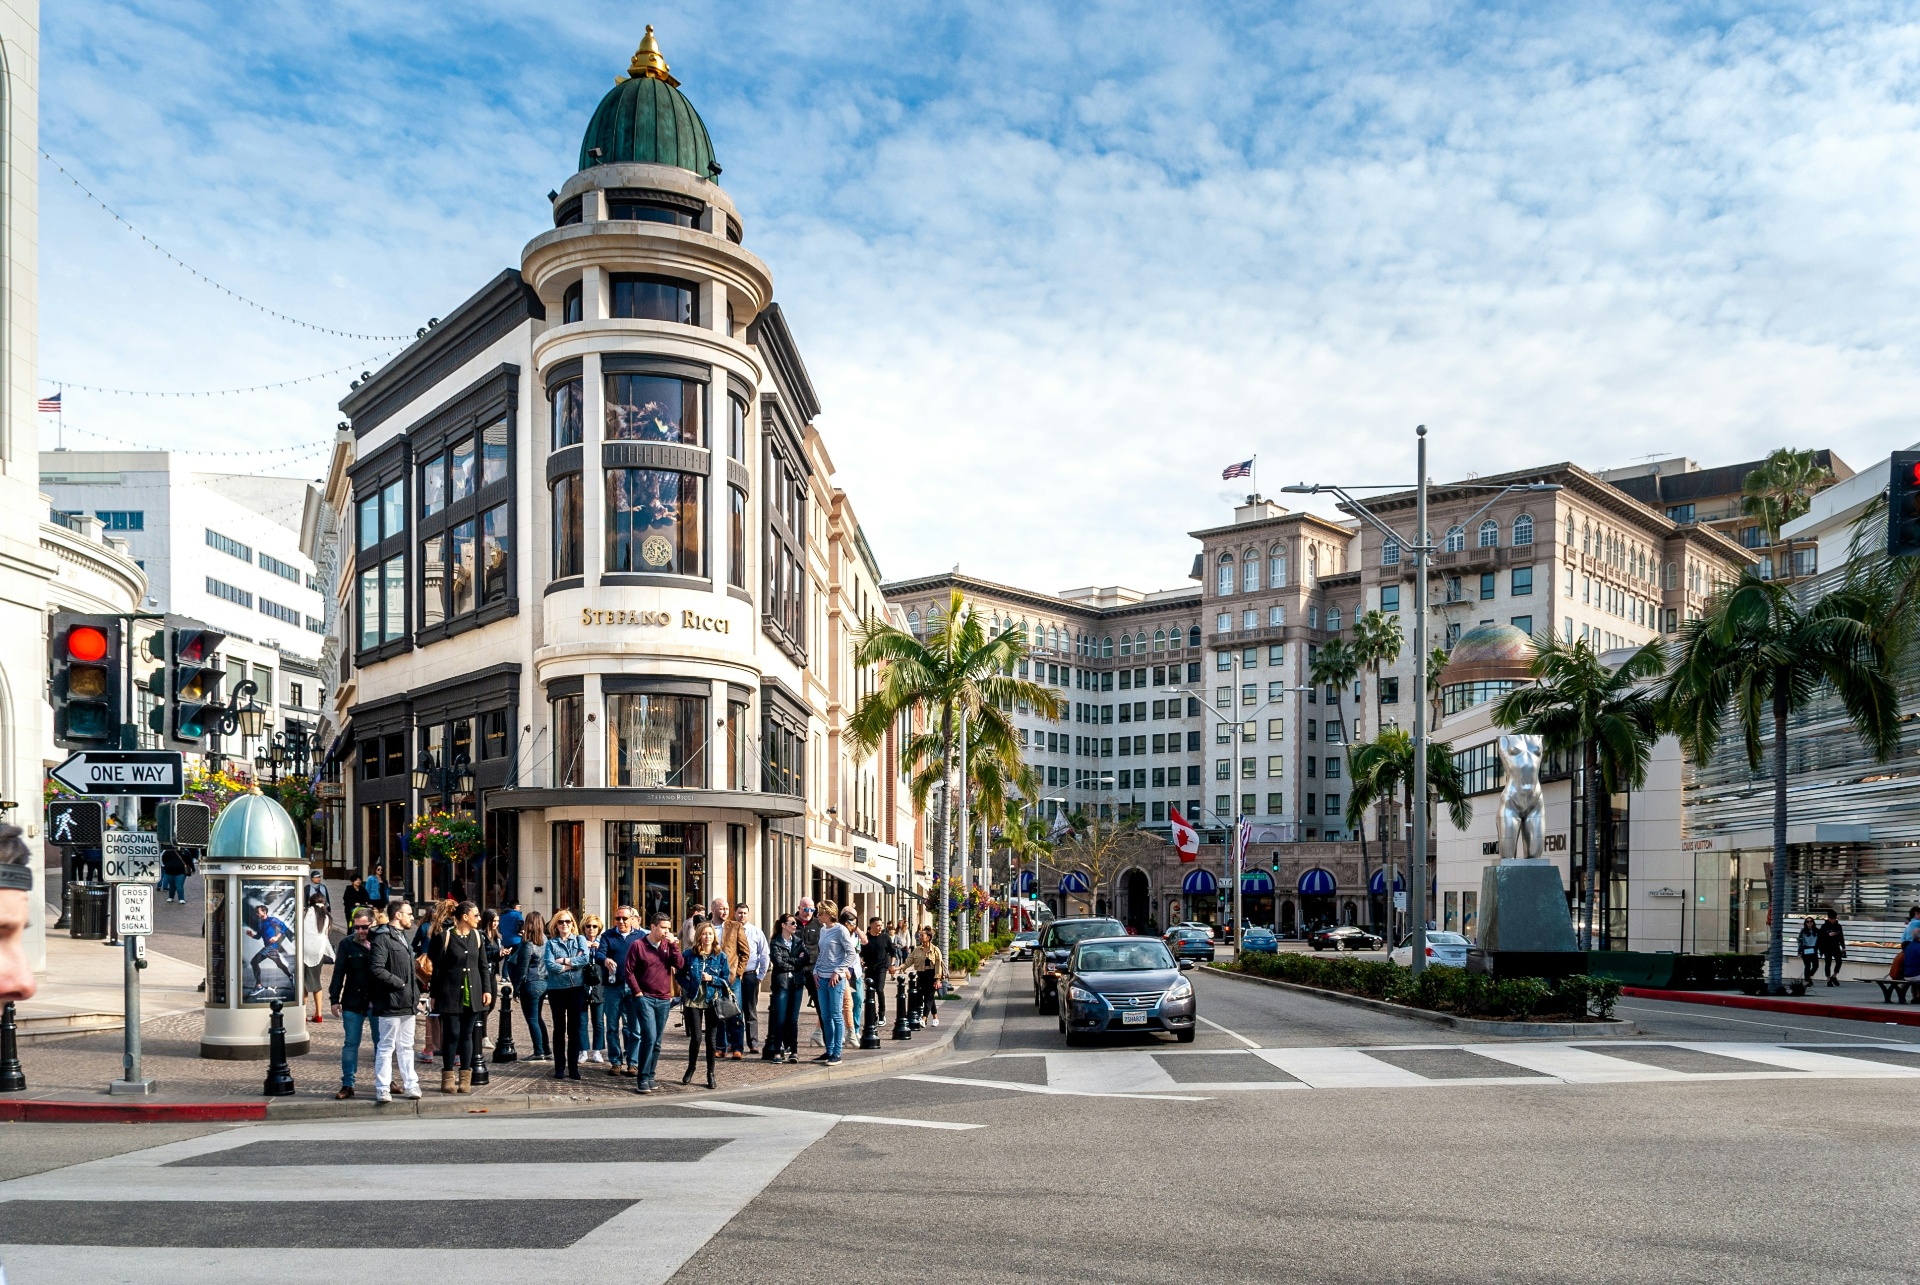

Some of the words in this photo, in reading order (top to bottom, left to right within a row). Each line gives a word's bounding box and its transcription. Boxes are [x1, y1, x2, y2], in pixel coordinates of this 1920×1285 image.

[581, 608, 671, 626] STEFANO
[681, 609, 730, 634] RICCI
[91, 766, 124, 781] ONE
[132, 766, 165, 781] WAY
[106, 834, 157, 844] DIAGONAL
[1544, 834, 1567, 851] FENDI
[1682, 841, 1694, 852] LOUIS
[1695, 840, 1713, 849] VUITTON
[105, 845, 158, 855] CROSSING
[106, 860, 126, 876] OK
